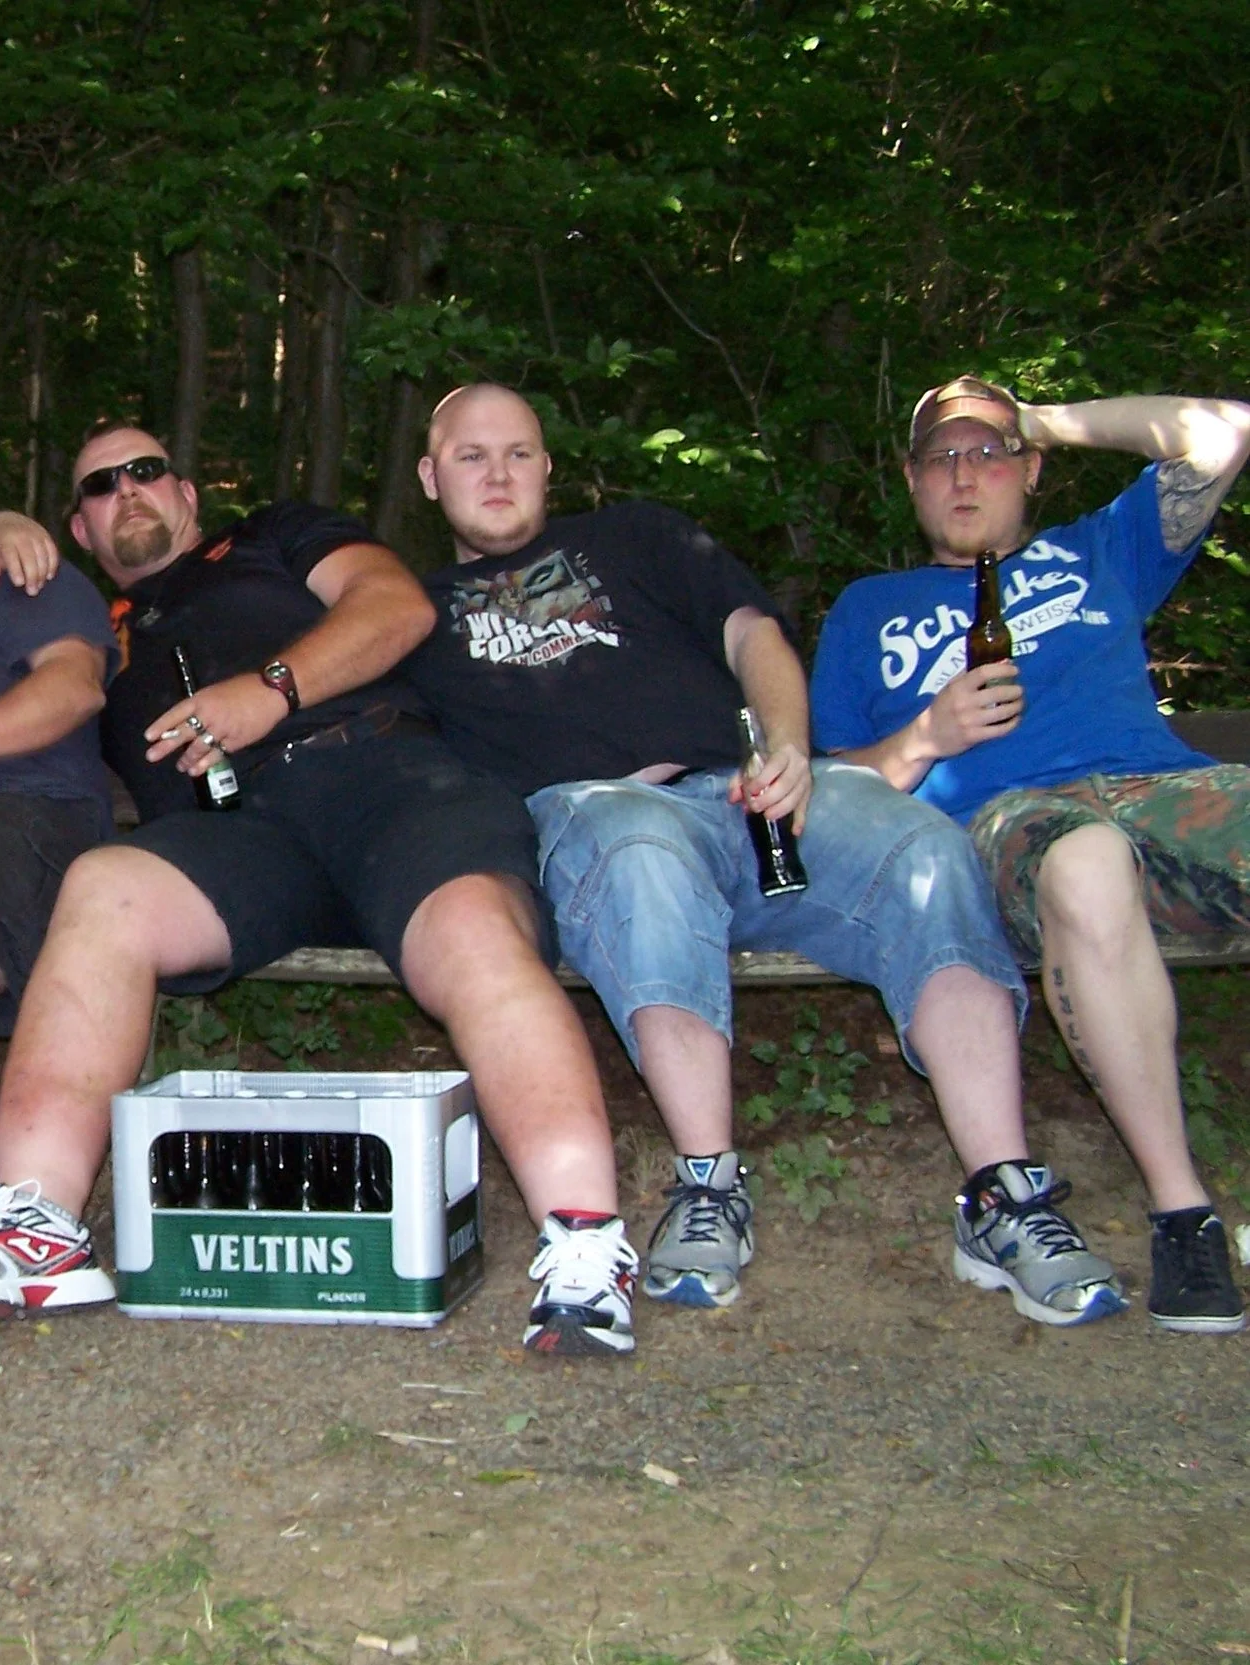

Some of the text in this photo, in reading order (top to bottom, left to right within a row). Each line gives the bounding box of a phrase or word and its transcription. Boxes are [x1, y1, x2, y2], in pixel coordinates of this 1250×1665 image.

[879, 569, 1066, 690] Schlke
[1011, 599, 1075, 634] WEISS
[190, 1233, 354, 1275] VELTINS
